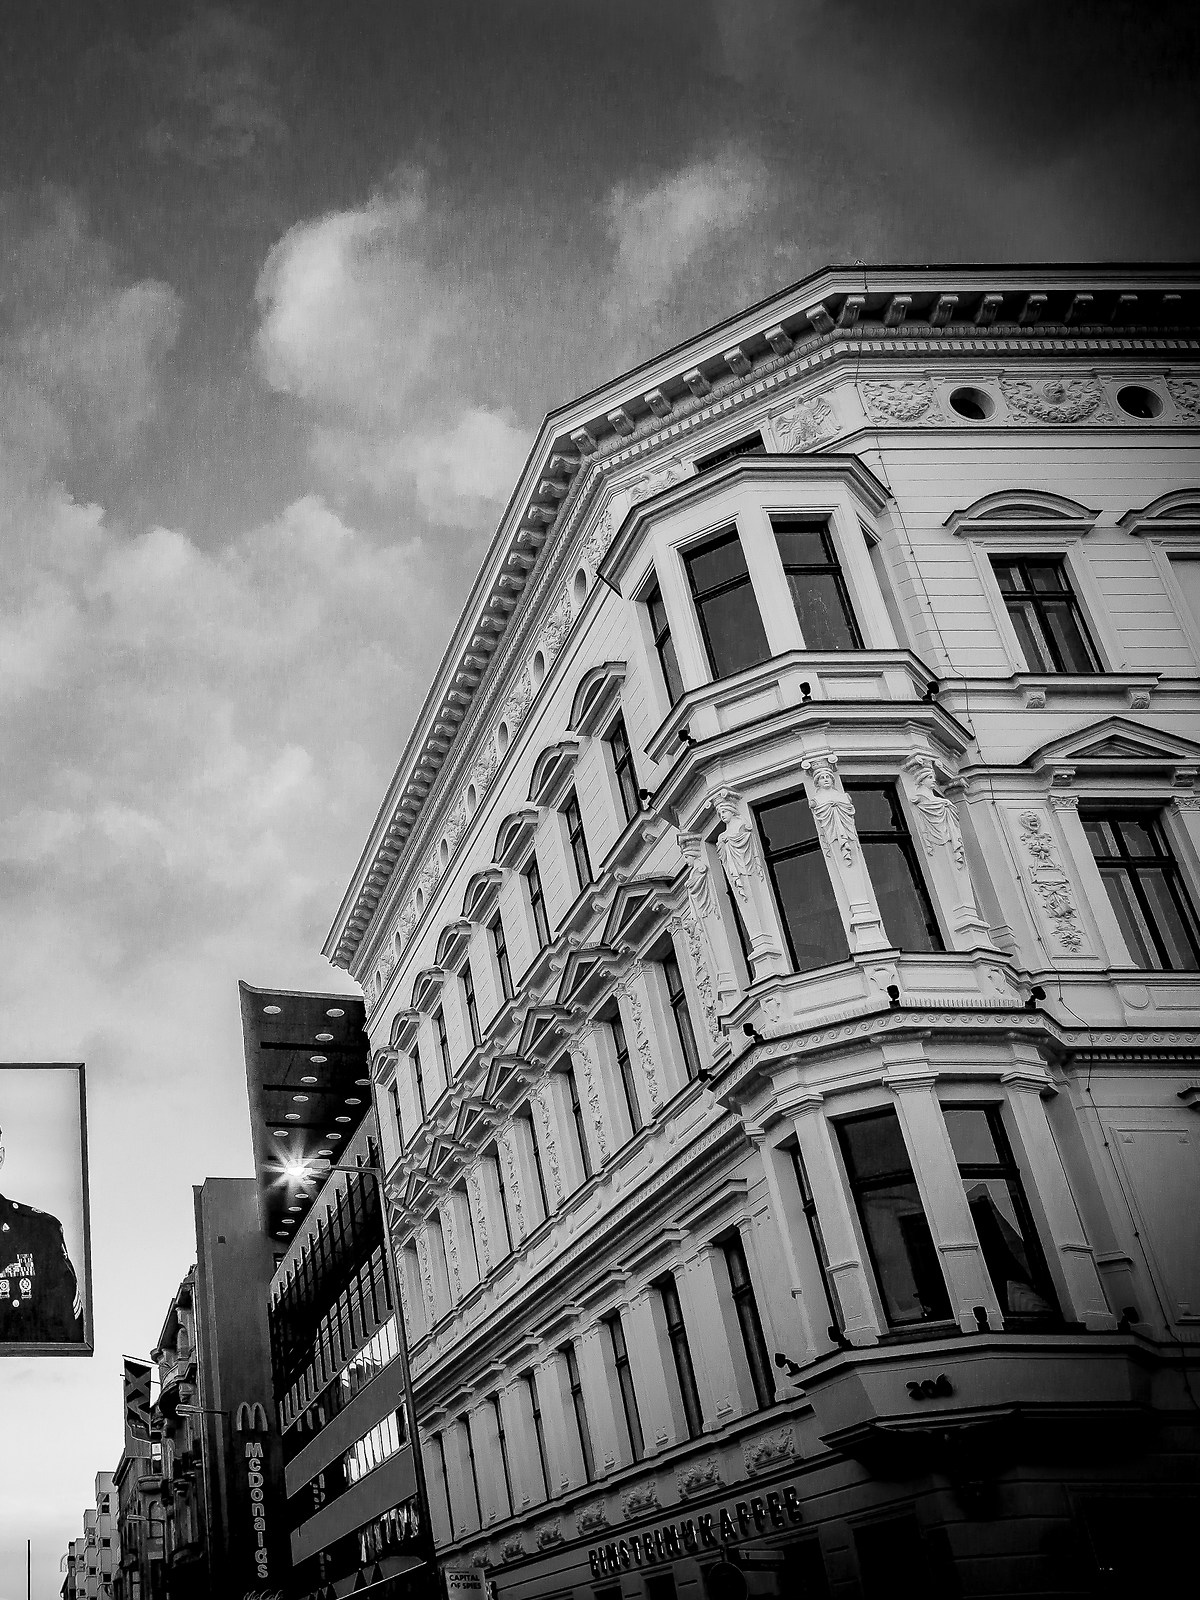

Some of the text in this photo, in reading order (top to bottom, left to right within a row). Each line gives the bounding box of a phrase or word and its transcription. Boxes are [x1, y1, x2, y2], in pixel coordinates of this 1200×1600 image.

[588, 1486, 803, 1578] EINSTEIN KAFFEE
[462, 1582, 482, 1590] SPIES
